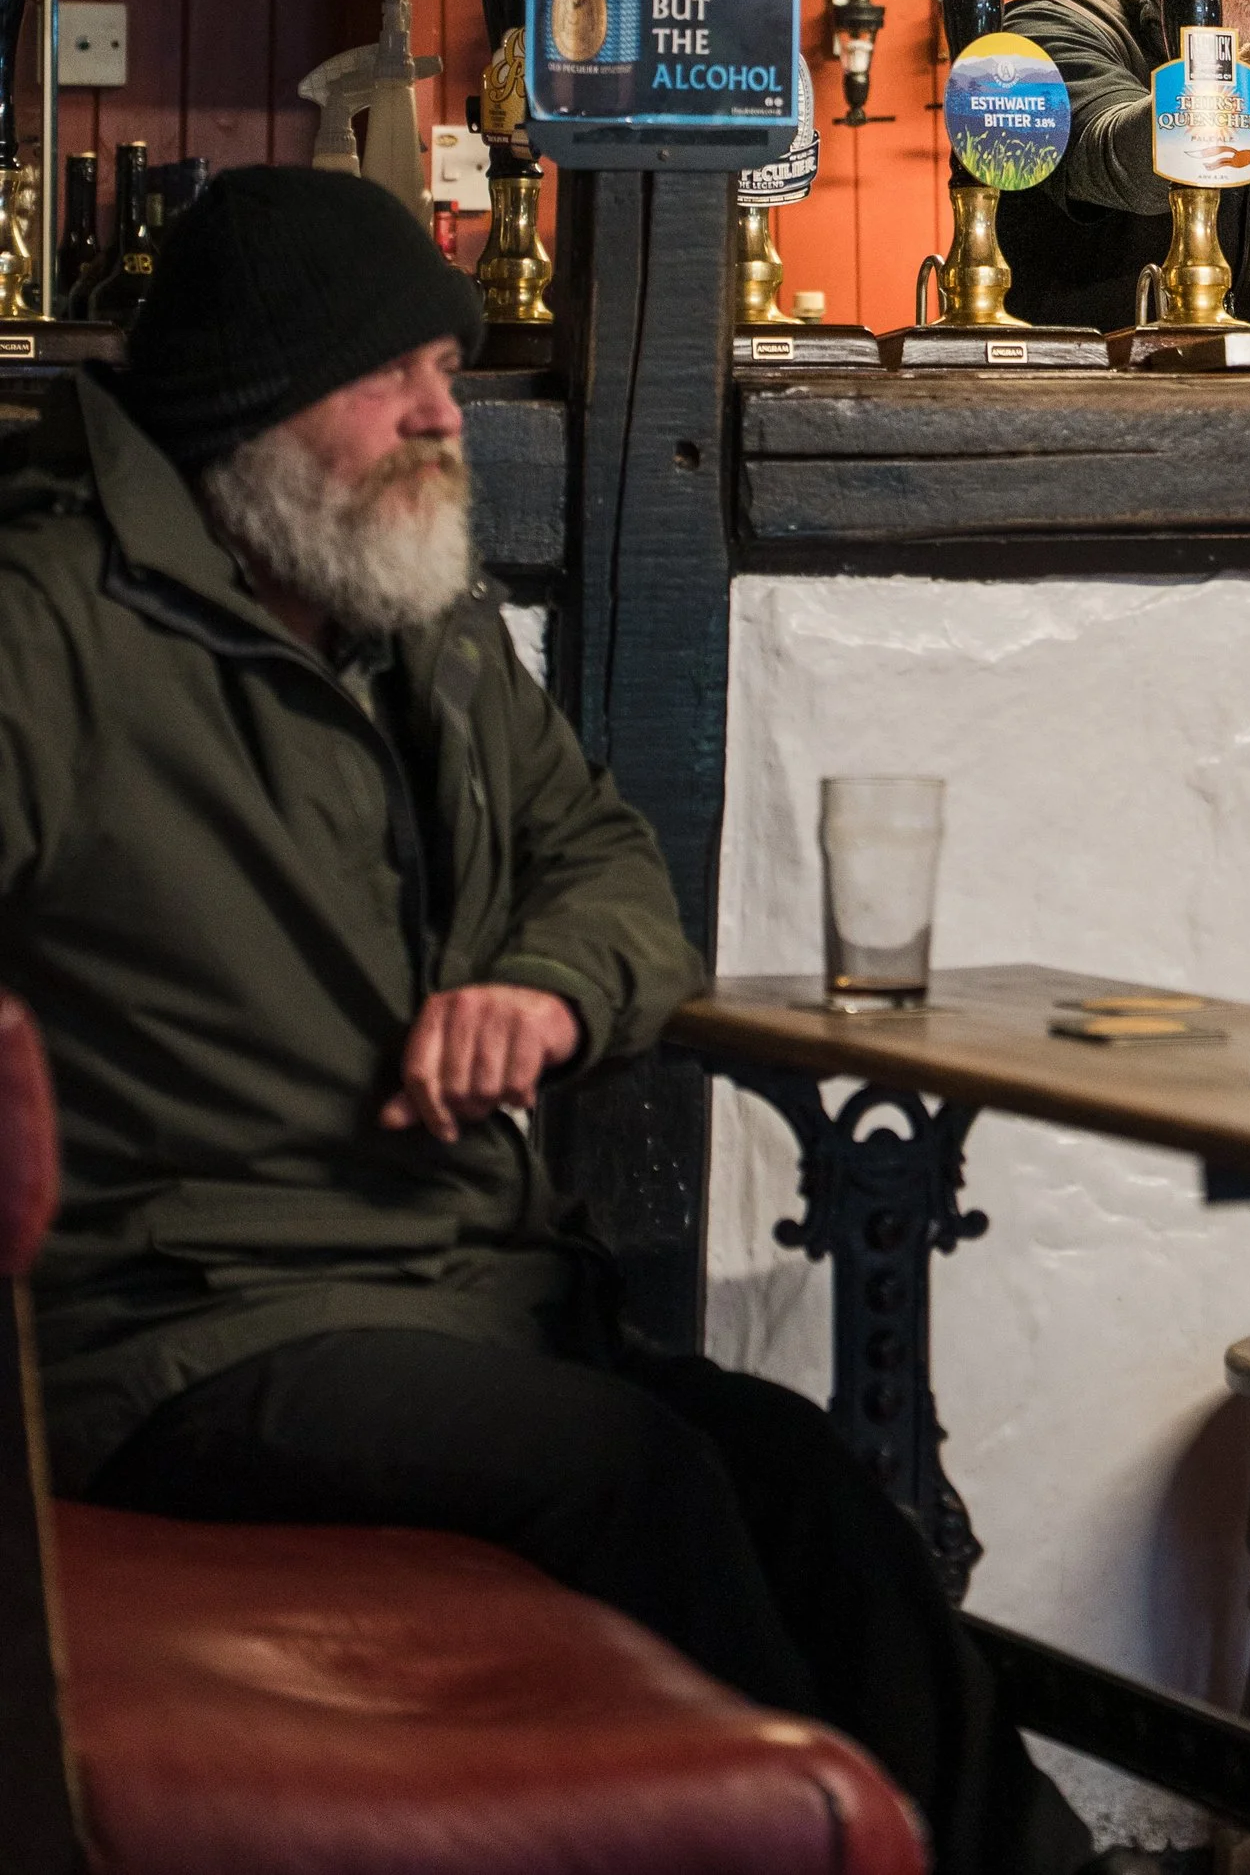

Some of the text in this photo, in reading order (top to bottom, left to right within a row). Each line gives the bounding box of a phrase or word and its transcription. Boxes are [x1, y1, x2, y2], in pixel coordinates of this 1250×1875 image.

[652, 28, 710, 55] THE
[651, 63, 783, 92] ALCOHOL
[970, 96, 1046, 111] ESTHWAITE
[1177, 95, 1245, 112] THIRST
[984, 113, 1056, 128] BITTER 3.8%
[752, 180, 785, 190] LEGEND
[757, 345, 790, 353] ANGRAM
[991, 348, 1023, 357] ANGRAM
